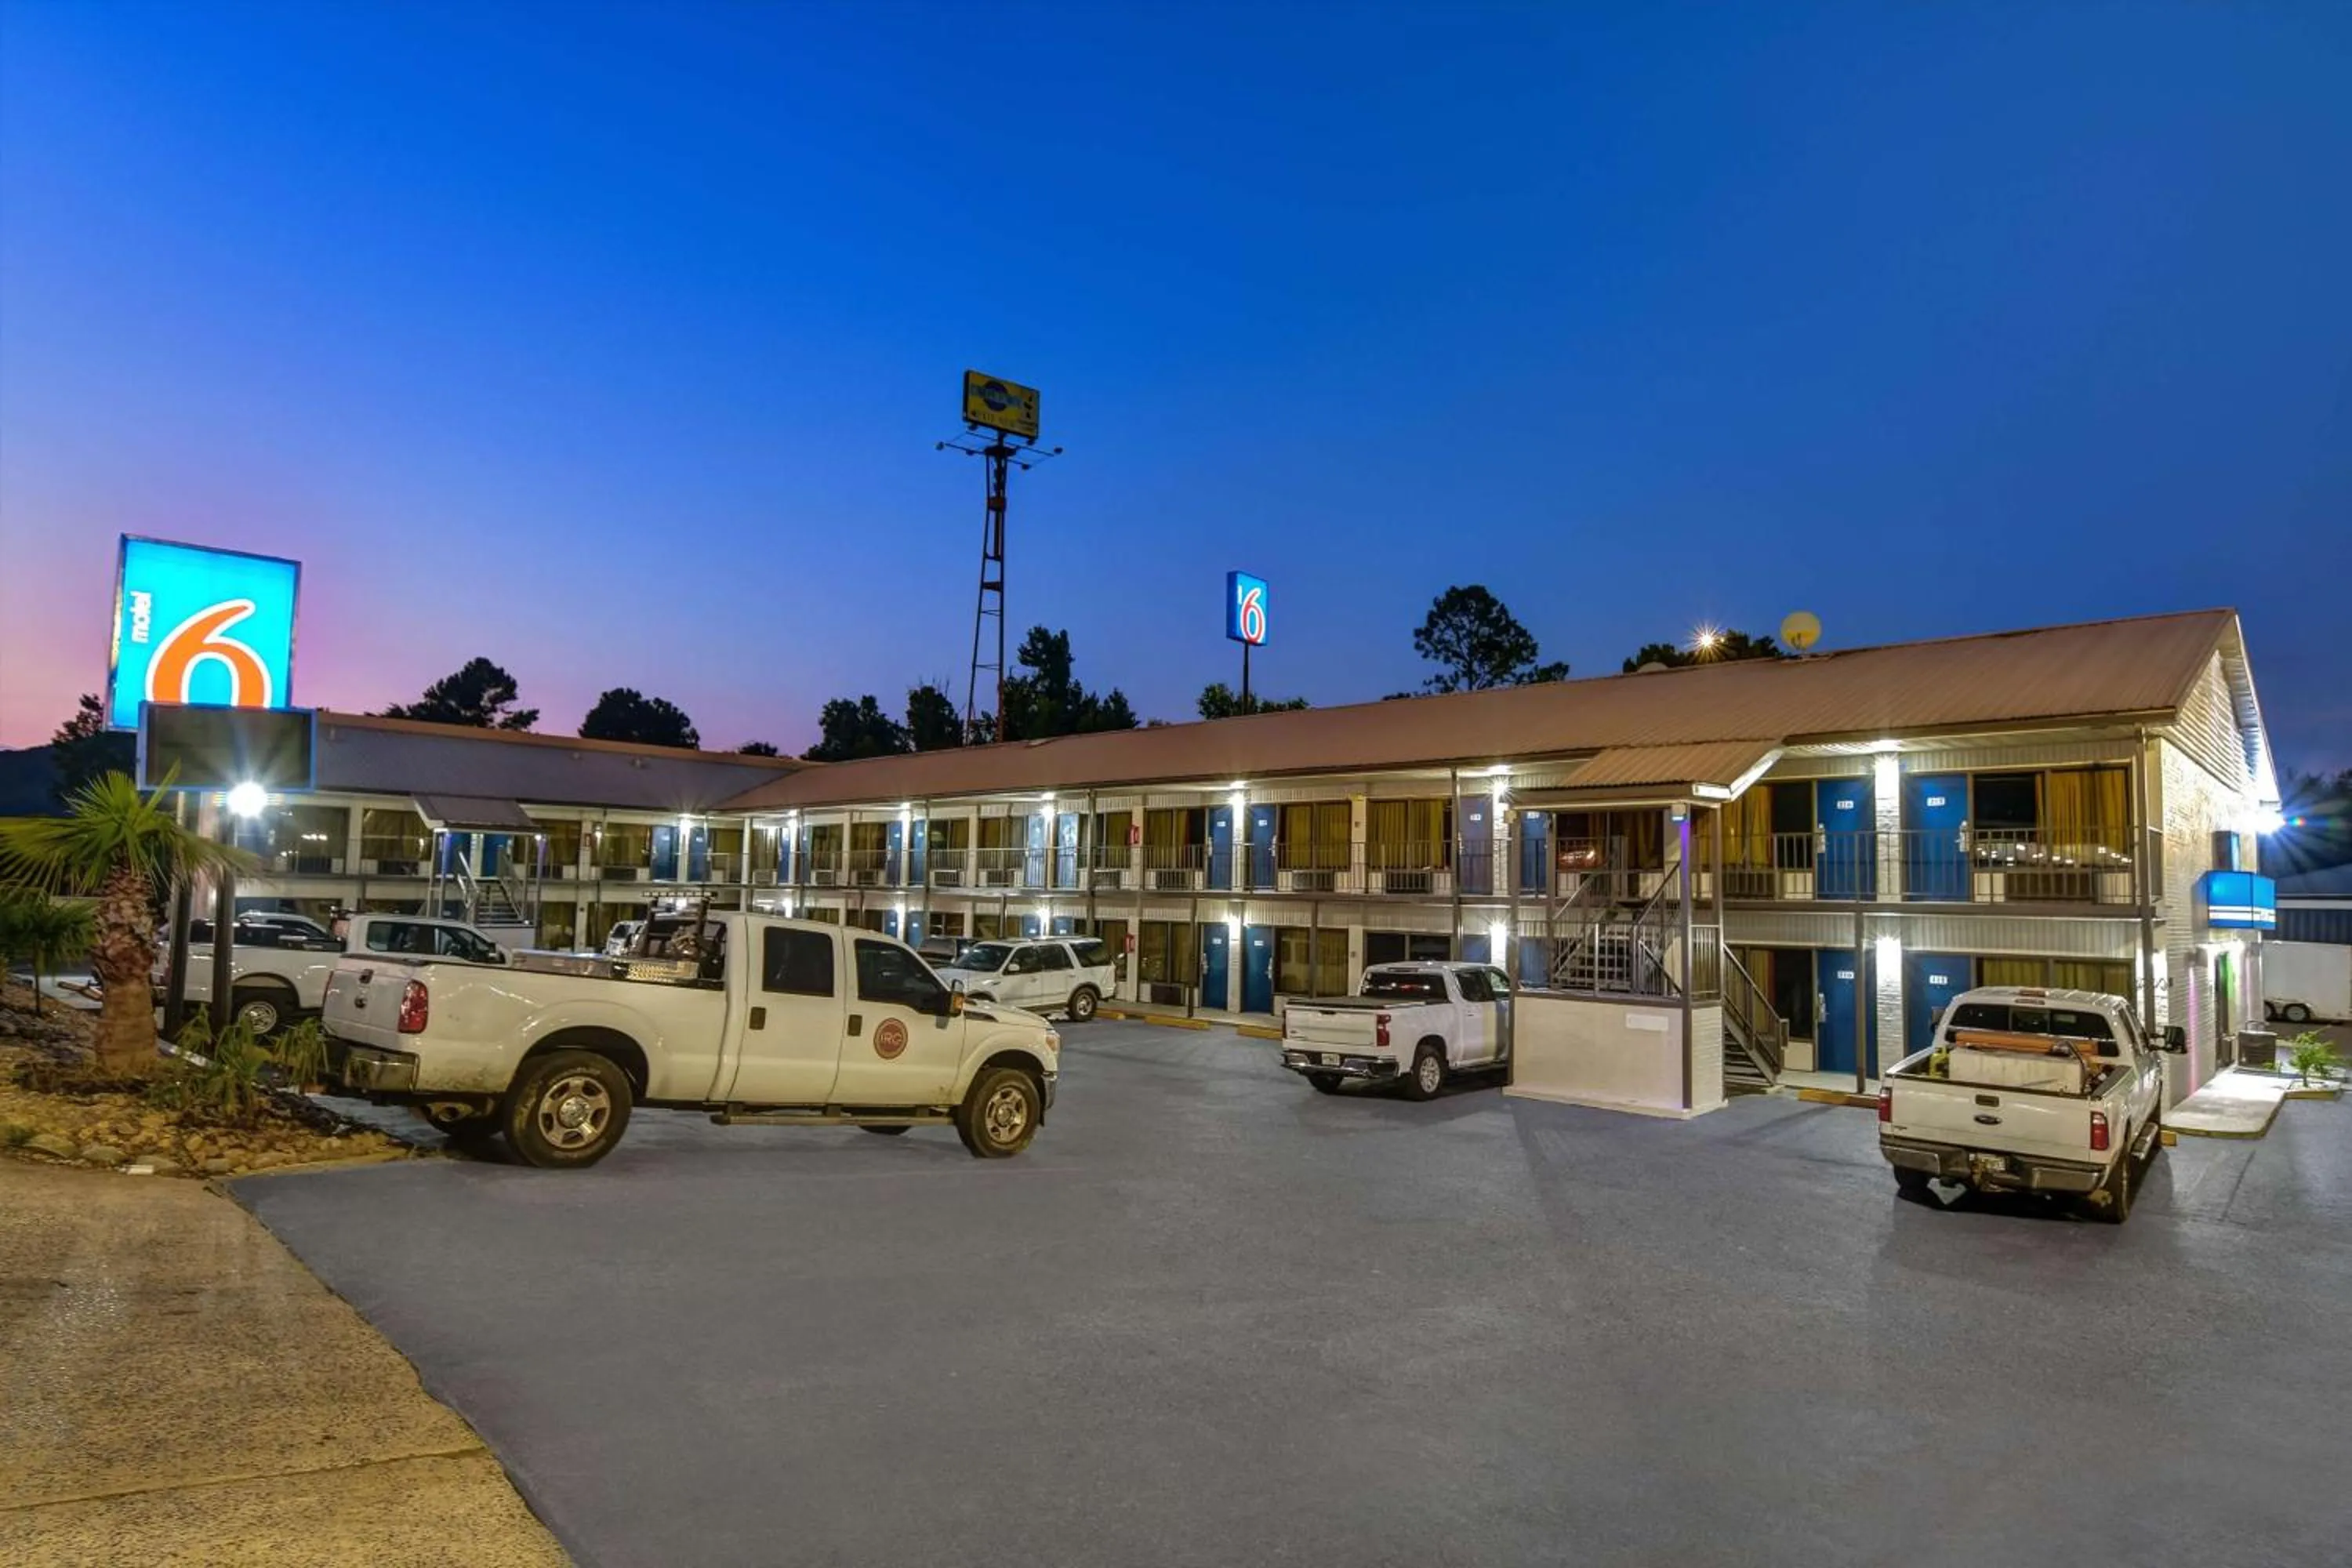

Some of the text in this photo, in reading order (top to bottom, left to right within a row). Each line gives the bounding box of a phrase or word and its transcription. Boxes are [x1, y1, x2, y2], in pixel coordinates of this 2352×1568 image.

[129, 591, 151, 644] motel
[1240, 588, 1265, 643] 6
[145, 598, 272, 709] 6
